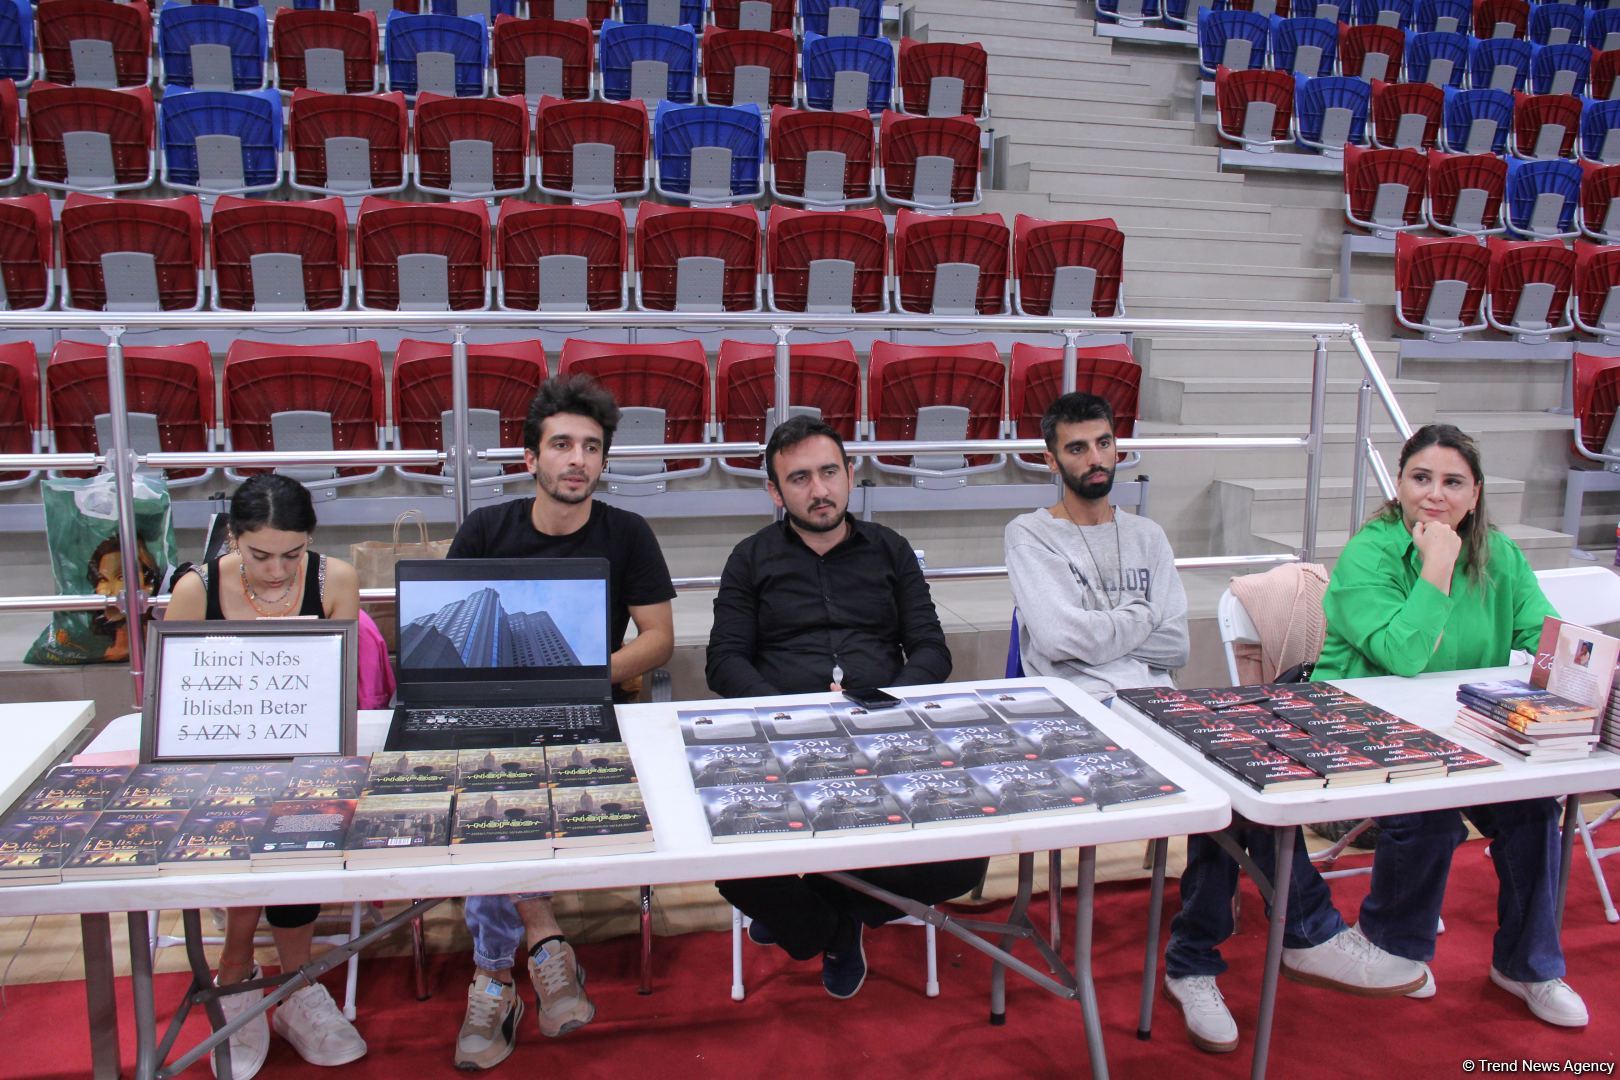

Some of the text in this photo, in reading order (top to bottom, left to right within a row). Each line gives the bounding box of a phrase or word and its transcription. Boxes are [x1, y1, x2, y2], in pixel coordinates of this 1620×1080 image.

[193, 648, 300, 667] İkinci Nəfəs
[180, 674, 310, 691] 8 AZN 5 AZN
[183, 697, 308, 716] İblisdən Betər
[1032, 718, 1068, 728] SON
[178, 723, 308, 741] 5 AZN 3 AZN
[955, 726, 990, 735] SON
[874, 733, 911, 742] SON
[710, 745, 747, 753] SON
[793, 739, 831, 749] SON
[1074, 755, 1112, 766] SON
[991, 765, 1030, 775] SON
[906, 773, 946, 783] SON
[816, 780, 857, 790] SON
[725, 786, 766, 796] SON
